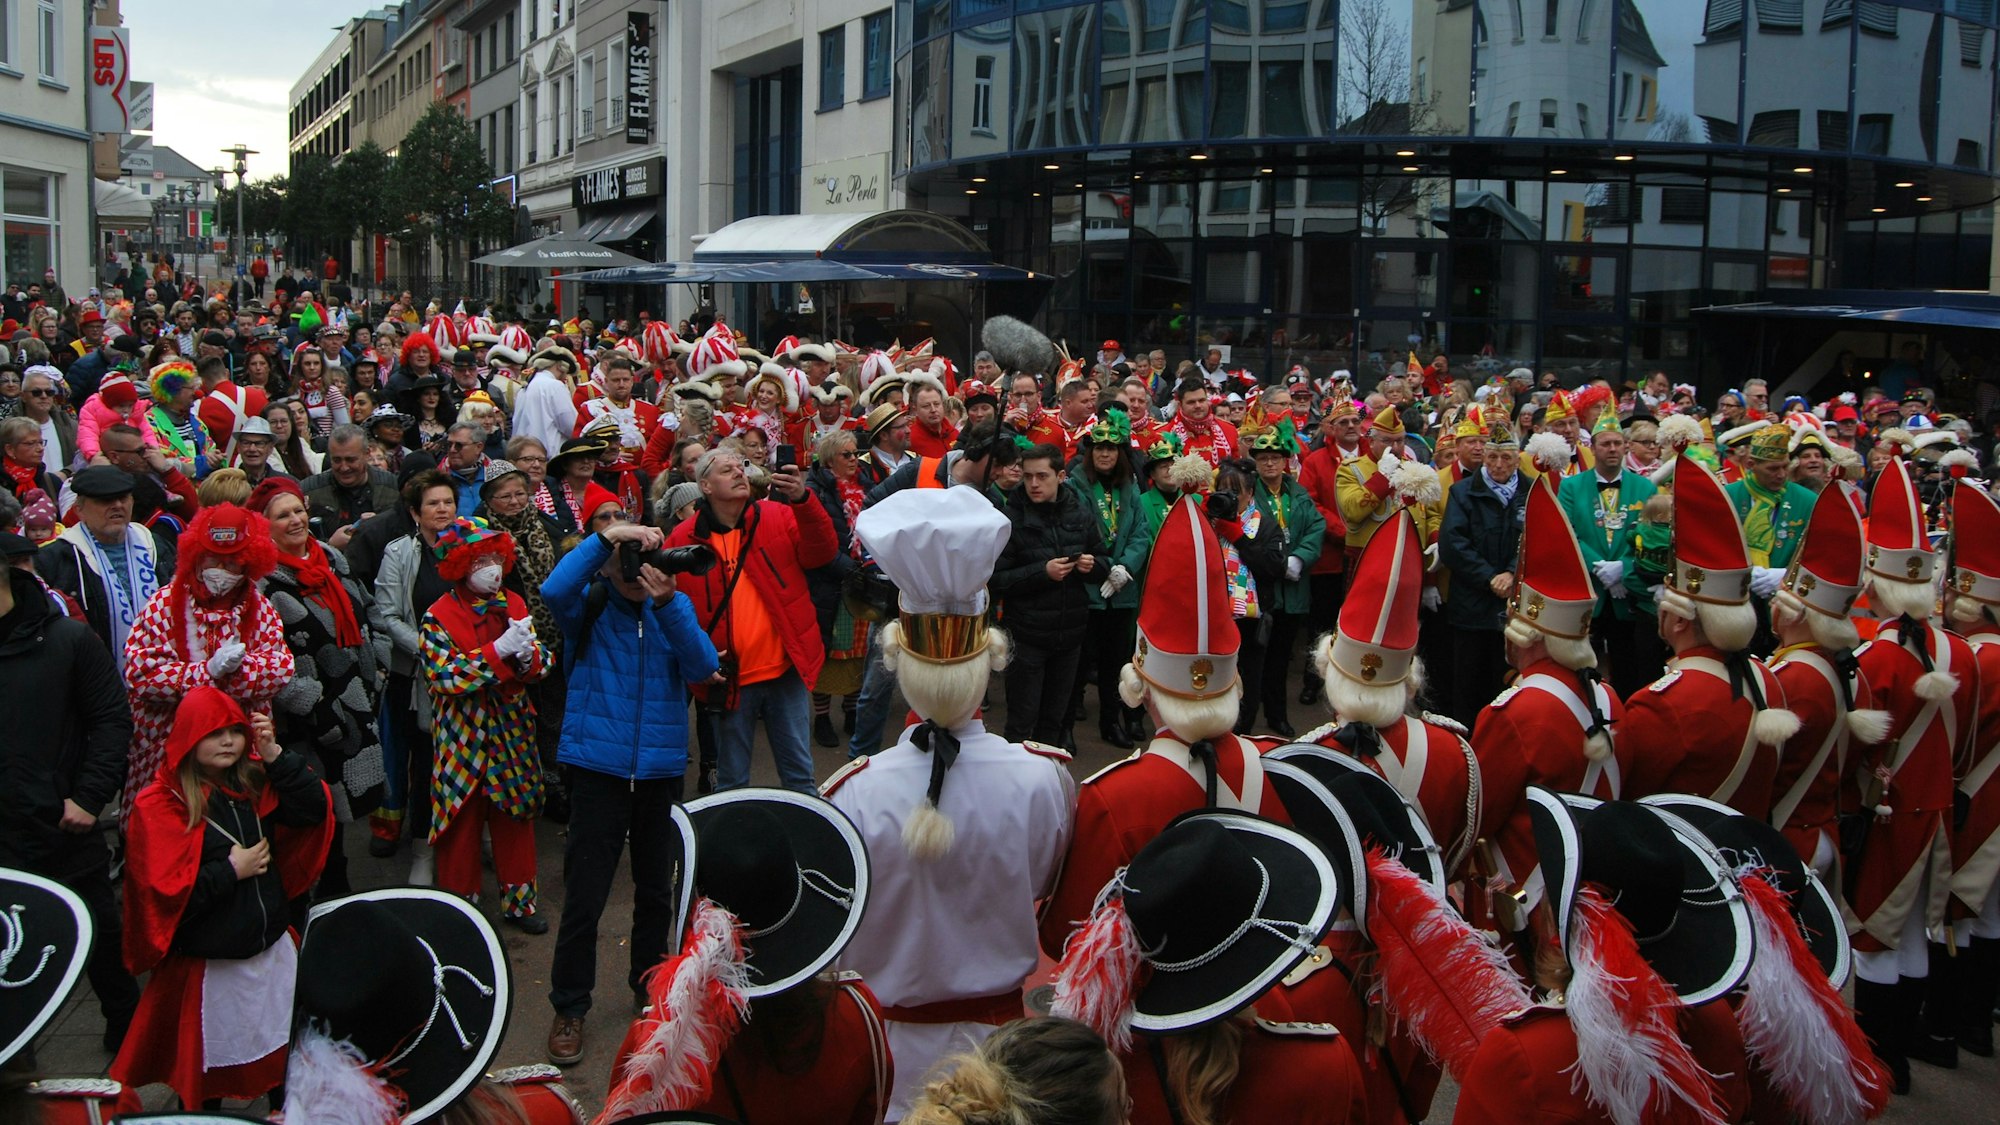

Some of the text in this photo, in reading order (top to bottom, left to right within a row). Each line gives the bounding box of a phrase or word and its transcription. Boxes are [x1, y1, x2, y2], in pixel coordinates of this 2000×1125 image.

[93, 38, 115, 87] LBS
[630, 45, 649, 118] FLAMES
[586, 167, 620, 204] FLAMES
[826, 177, 842, 205] La
